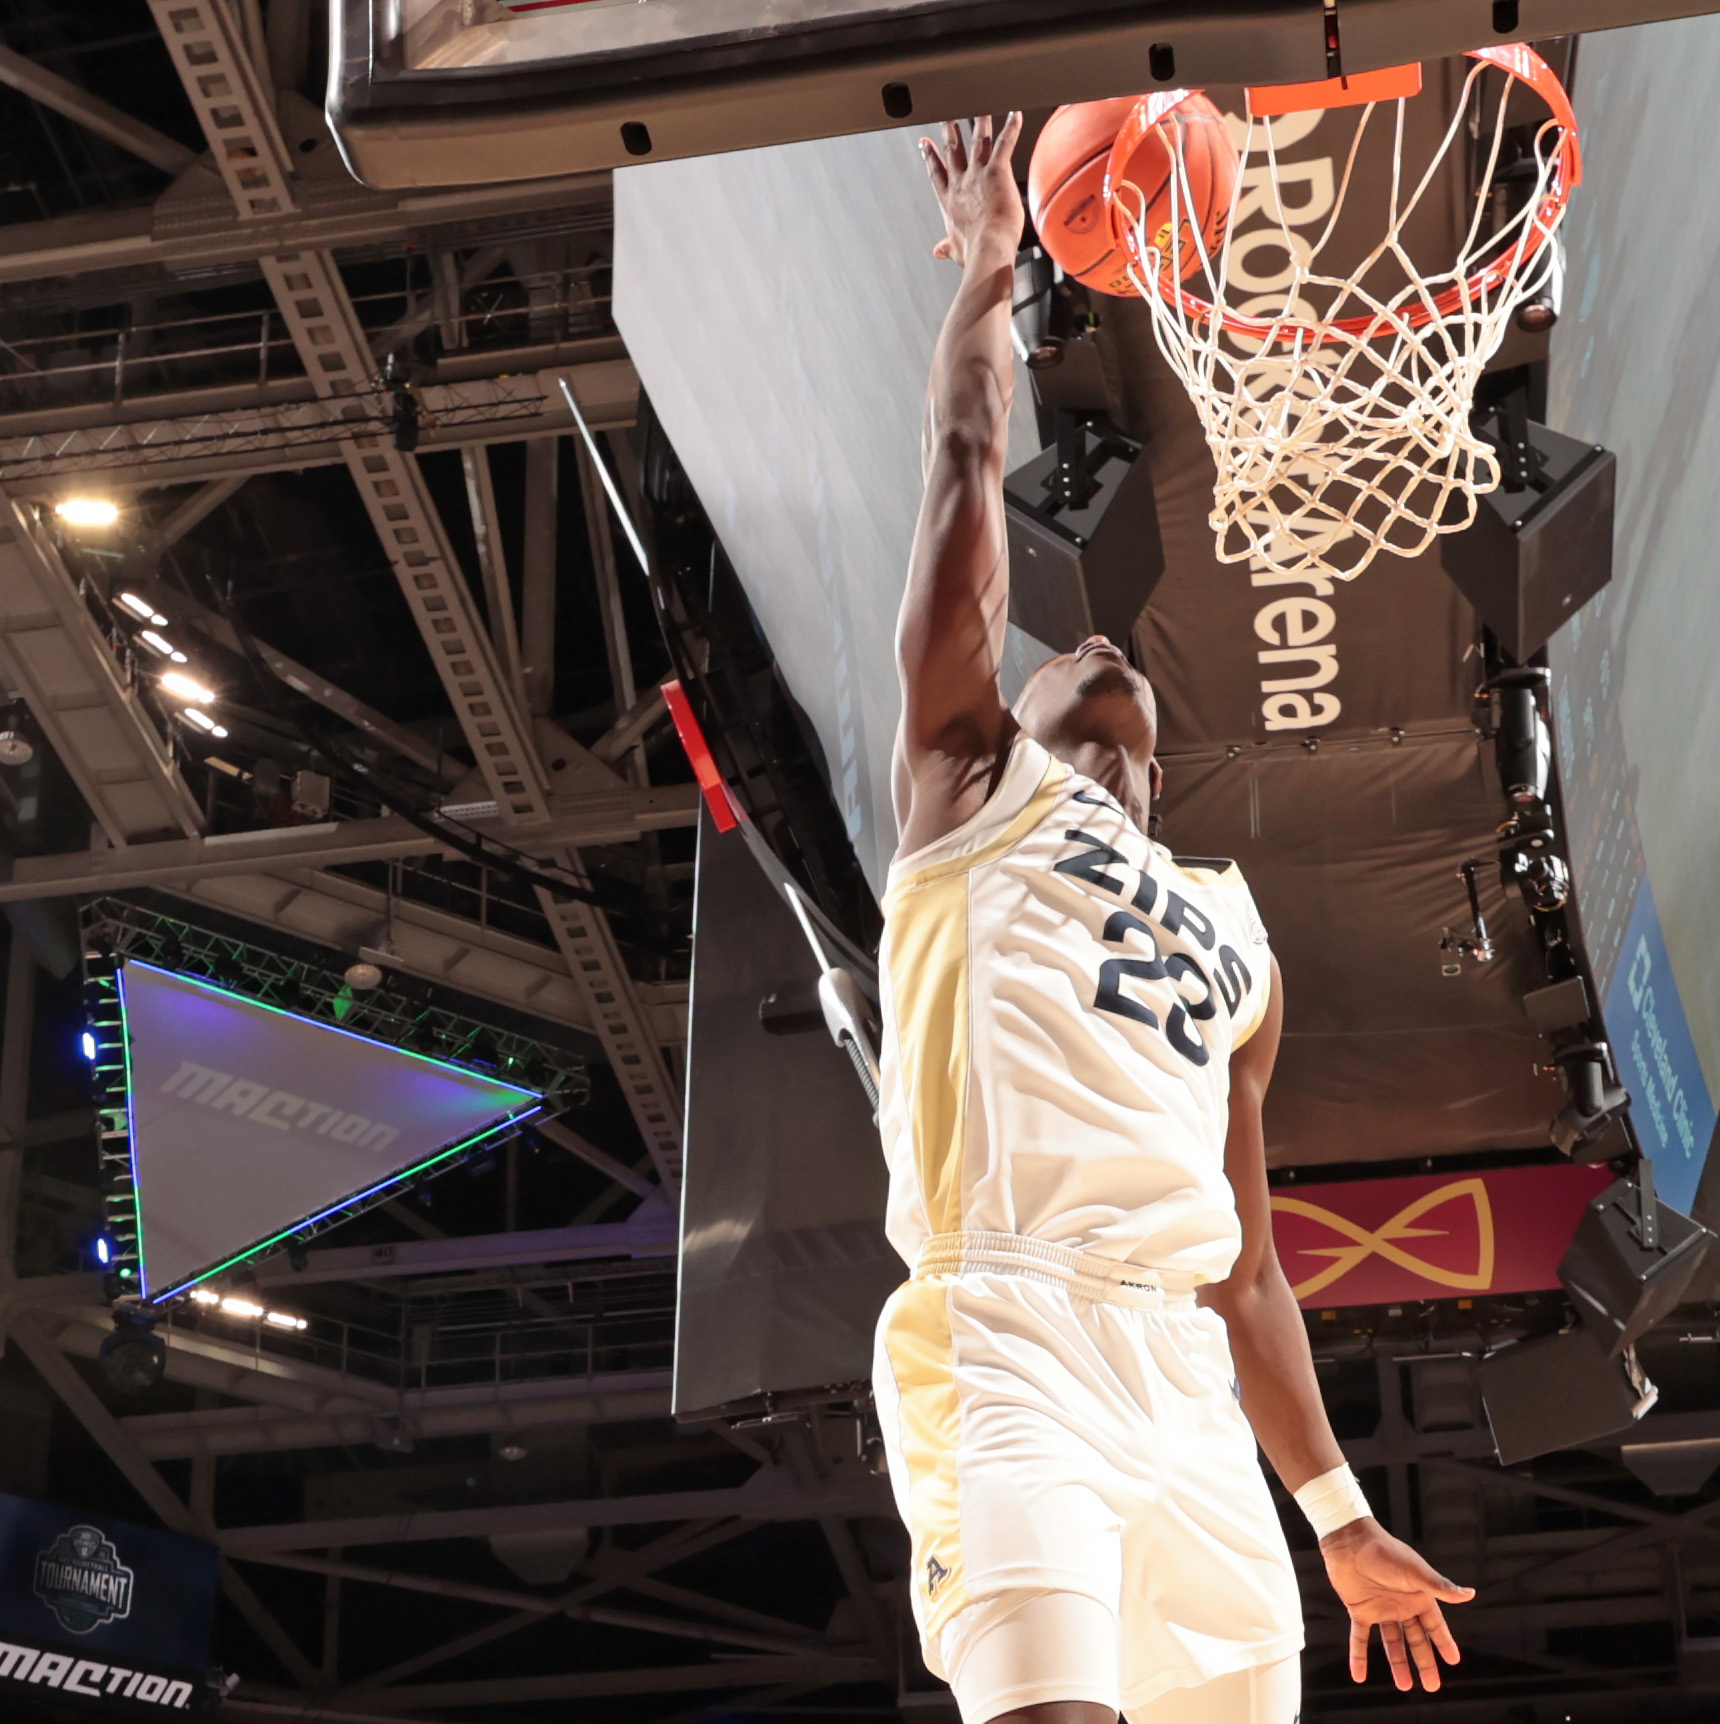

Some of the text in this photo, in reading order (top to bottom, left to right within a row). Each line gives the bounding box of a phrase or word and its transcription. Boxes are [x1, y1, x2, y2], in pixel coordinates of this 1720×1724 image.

[1053, 828, 1253, 1021] ZIPS
[159, 1059, 401, 1153] MACTION
[1120, 1279, 1158, 1293] AKRON
[40, 1559, 128, 1610] TOURNAMENT
[926, 1553, 952, 1597] A
